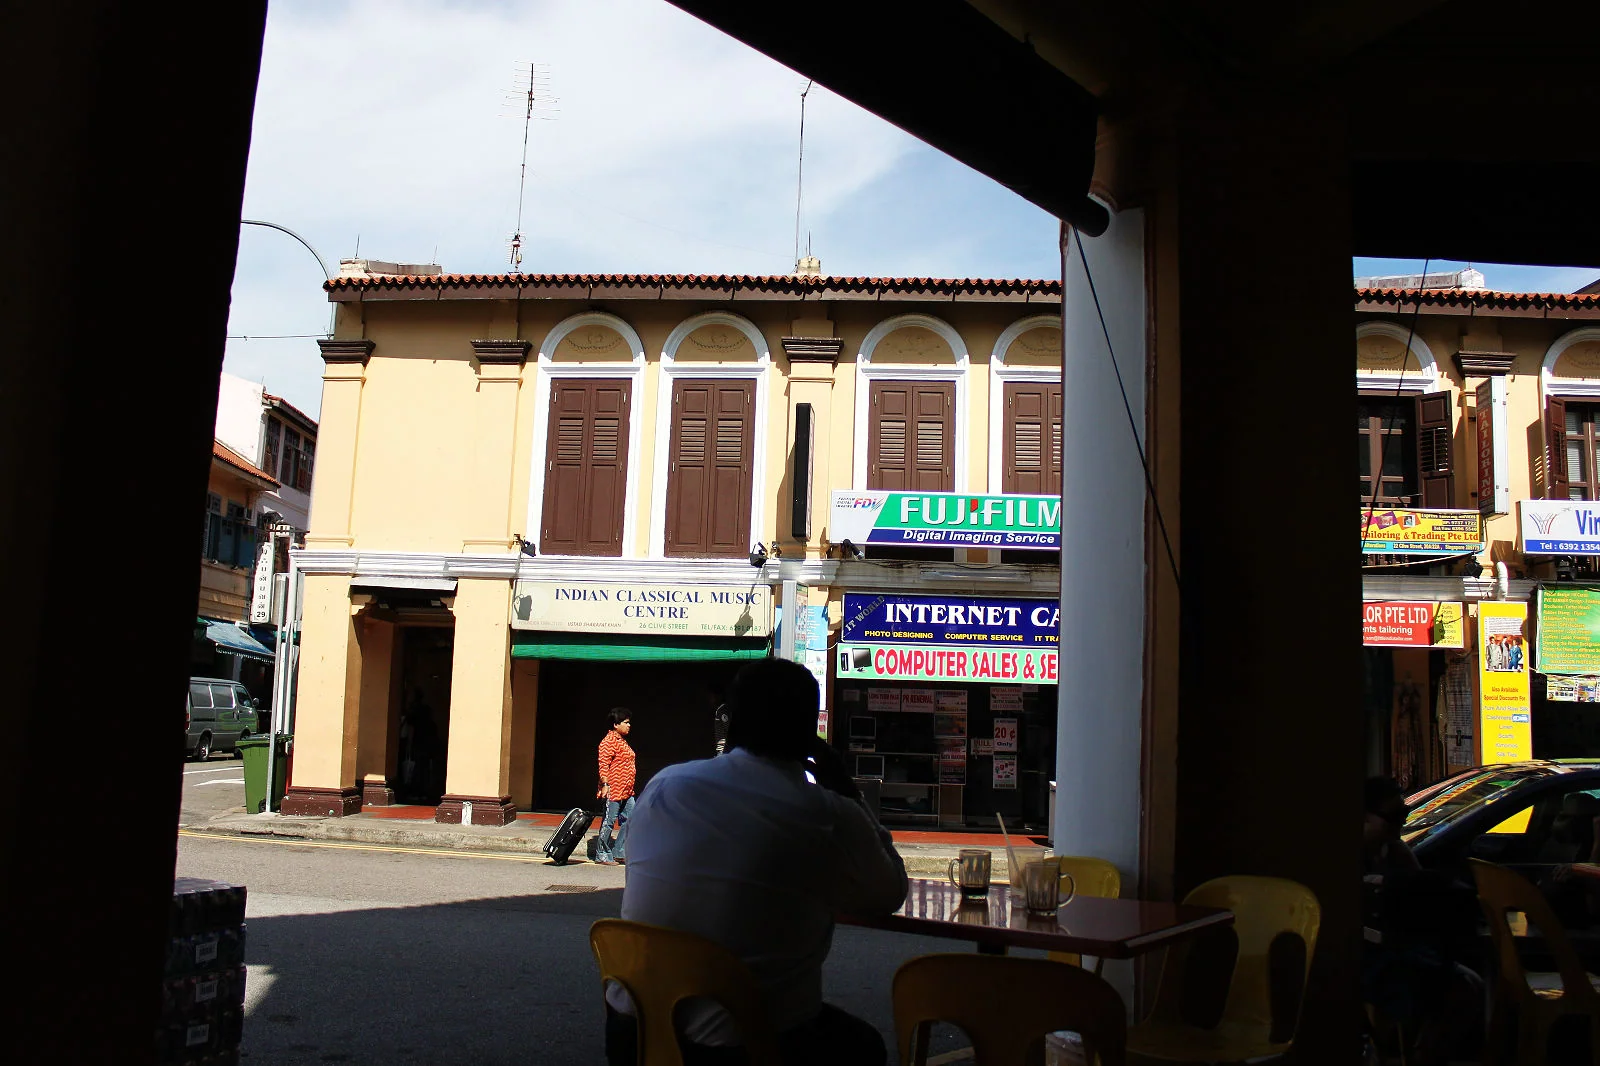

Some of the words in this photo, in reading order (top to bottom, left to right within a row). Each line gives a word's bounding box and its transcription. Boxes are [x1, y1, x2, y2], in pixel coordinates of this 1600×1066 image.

[900, 496, 1060, 528] FUJIFILM
[903, 530, 946, 542] Digital
[949, 531, 1002, 544] Imaging
[1005, 532, 1055, 544] Service
[1404, 532, 1410, 540] &
[1411, 532, 1446, 540] Trading
[1448, 532, 1462, 540] Pte
[555, 588, 609, 601] INDIAN
[616, 590, 704, 604] CLASSICAL
[710, 592, 762, 605] MUSIC
[624, 605, 689, 619] CENTRE
[845, 620, 856, 631] IT
[855, 596, 885, 622] WORLD
[886, 603, 1021, 627] INTERNET
[1030, 607, 1060, 627] CA
[1363, 606, 1382, 623] OR
[1385, 606, 1406, 624] PTE
[1408, 607, 1428, 624] LTD
[1378, 626, 1413, 636] tailoring
[874, 648, 967, 677] COMPUTER
[972, 651, 1018, 679] SALES
[1023, 653, 1035, 679] &
[1040, 653, 1058, 680] SE
[995, 727, 1007, 739] 20
